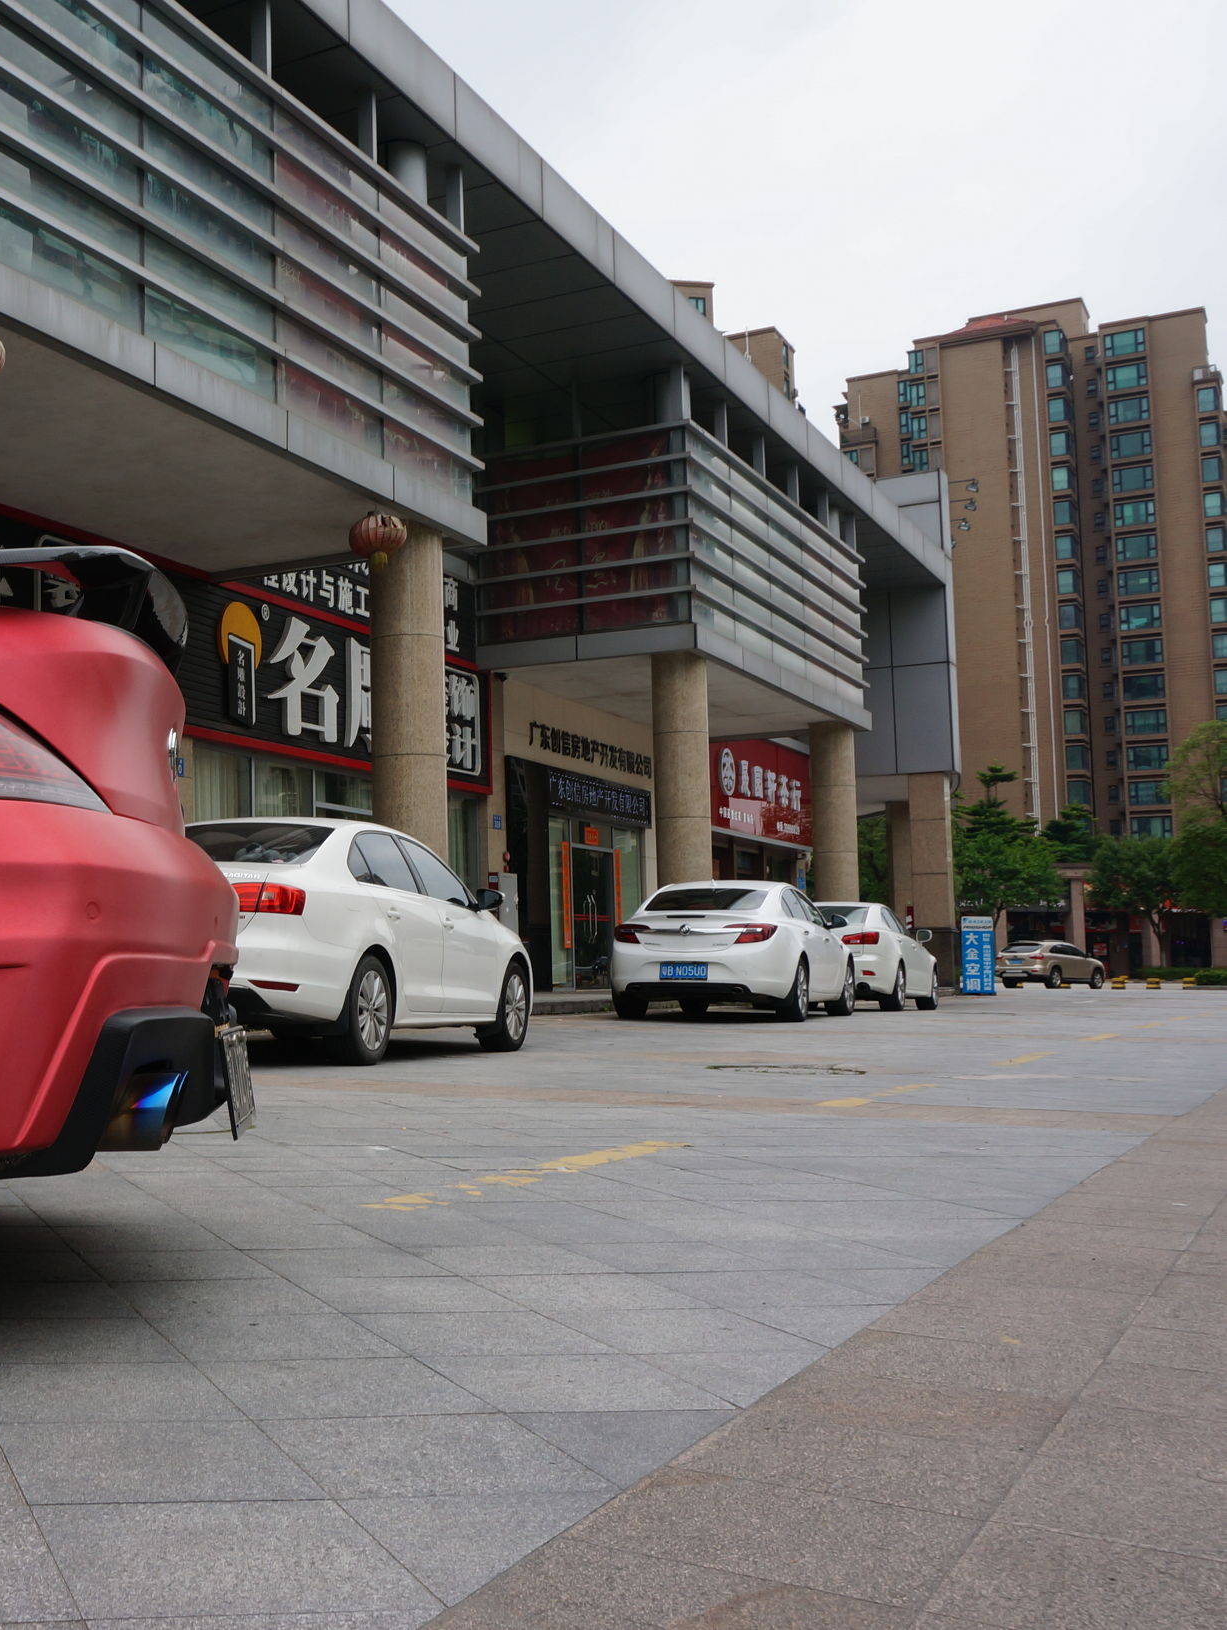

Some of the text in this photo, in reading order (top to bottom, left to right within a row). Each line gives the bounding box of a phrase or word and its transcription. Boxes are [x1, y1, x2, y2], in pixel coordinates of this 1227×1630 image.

[529, 720, 652, 780] 广东创信房地产开发有限公司
[965, 932, 981, 991] 大金空调
